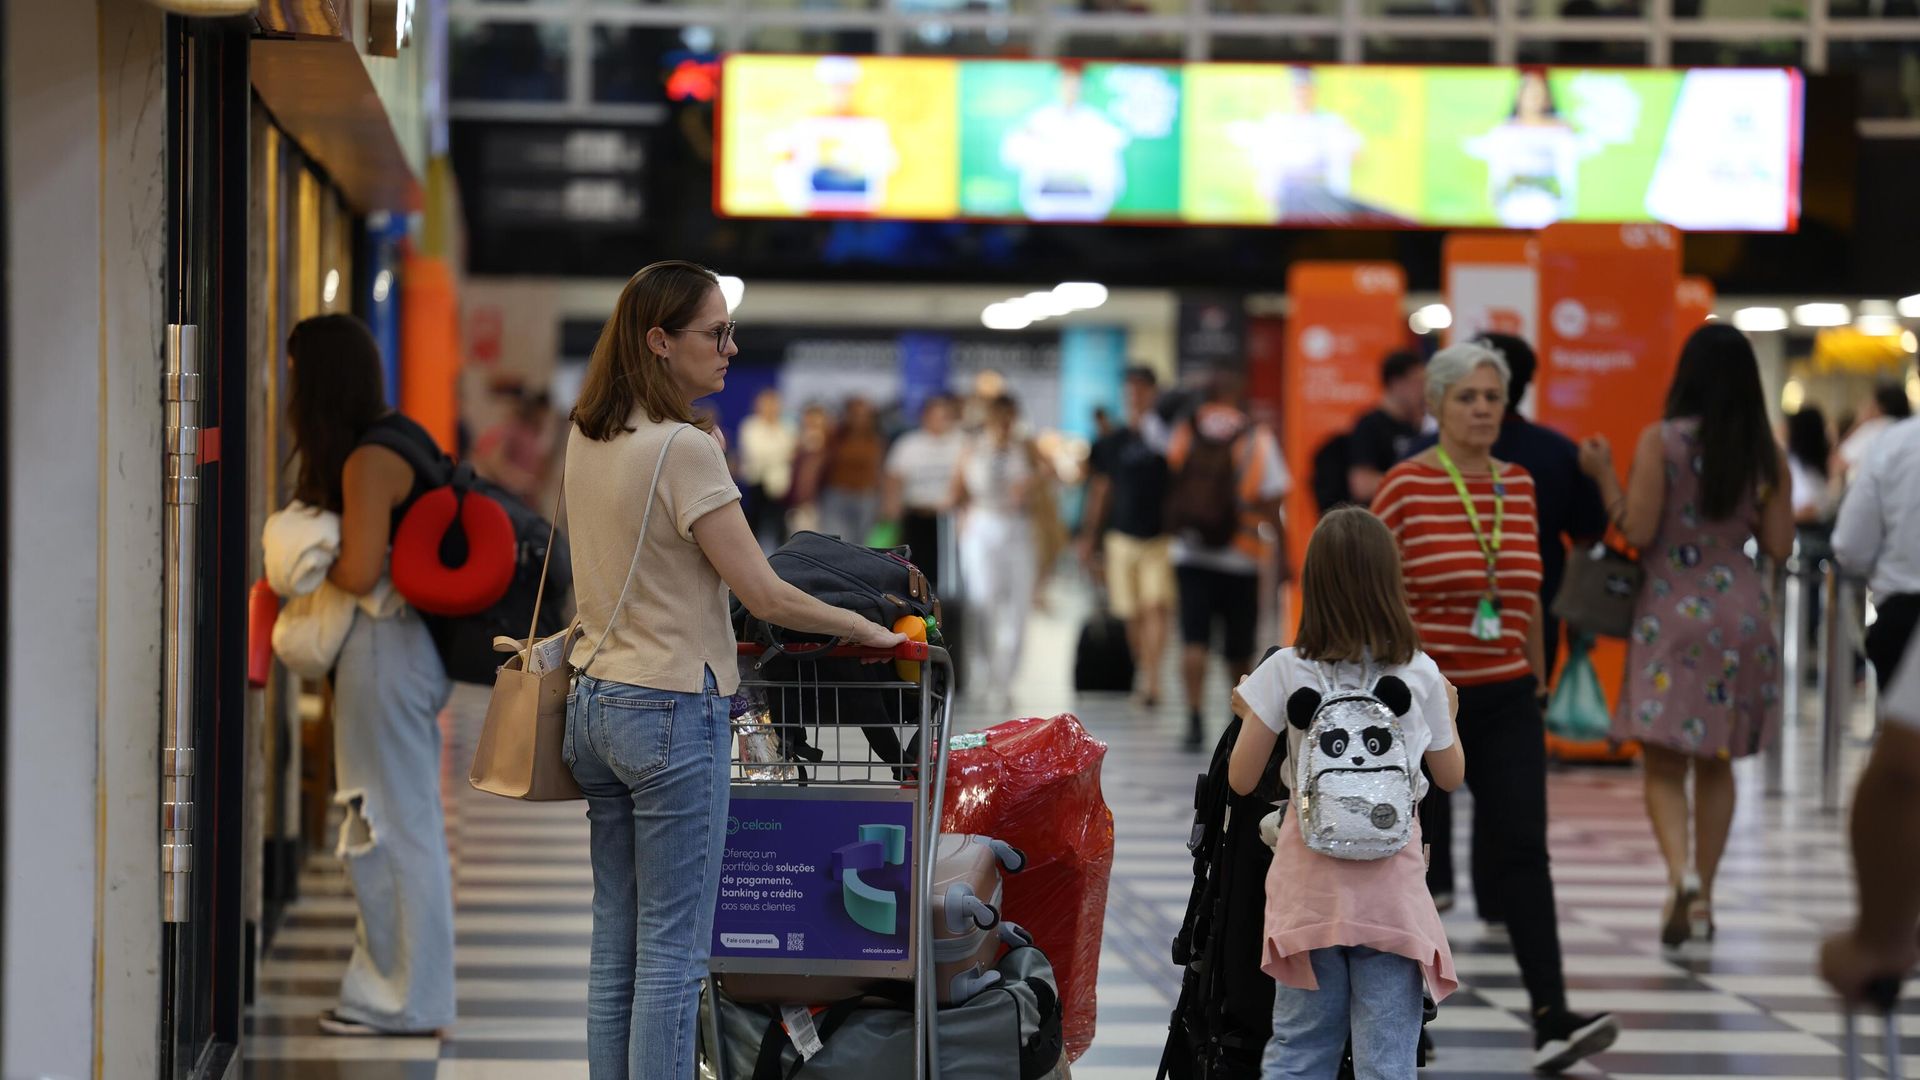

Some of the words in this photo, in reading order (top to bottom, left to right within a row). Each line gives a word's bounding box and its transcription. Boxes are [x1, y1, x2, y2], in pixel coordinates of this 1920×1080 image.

[742, 818, 782, 830] celcoin
[723, 848, 760, 860] Ofereça
[761, 850, 777, 859] um
[722, 861, 760, 873] portfólio
[761, 862, 774, 872] de
[775, 862, 815, 874] soluções
[722, 874, 734, 884] de
[722, 887, 760, 900] banking
[762, 890, 768, 898] e
[770, 888, 803, 898] crédito
[721, 902, 738, 911] aos
[739, 903, 760, 911] seus
[761, 901, 796, 912] clientes
